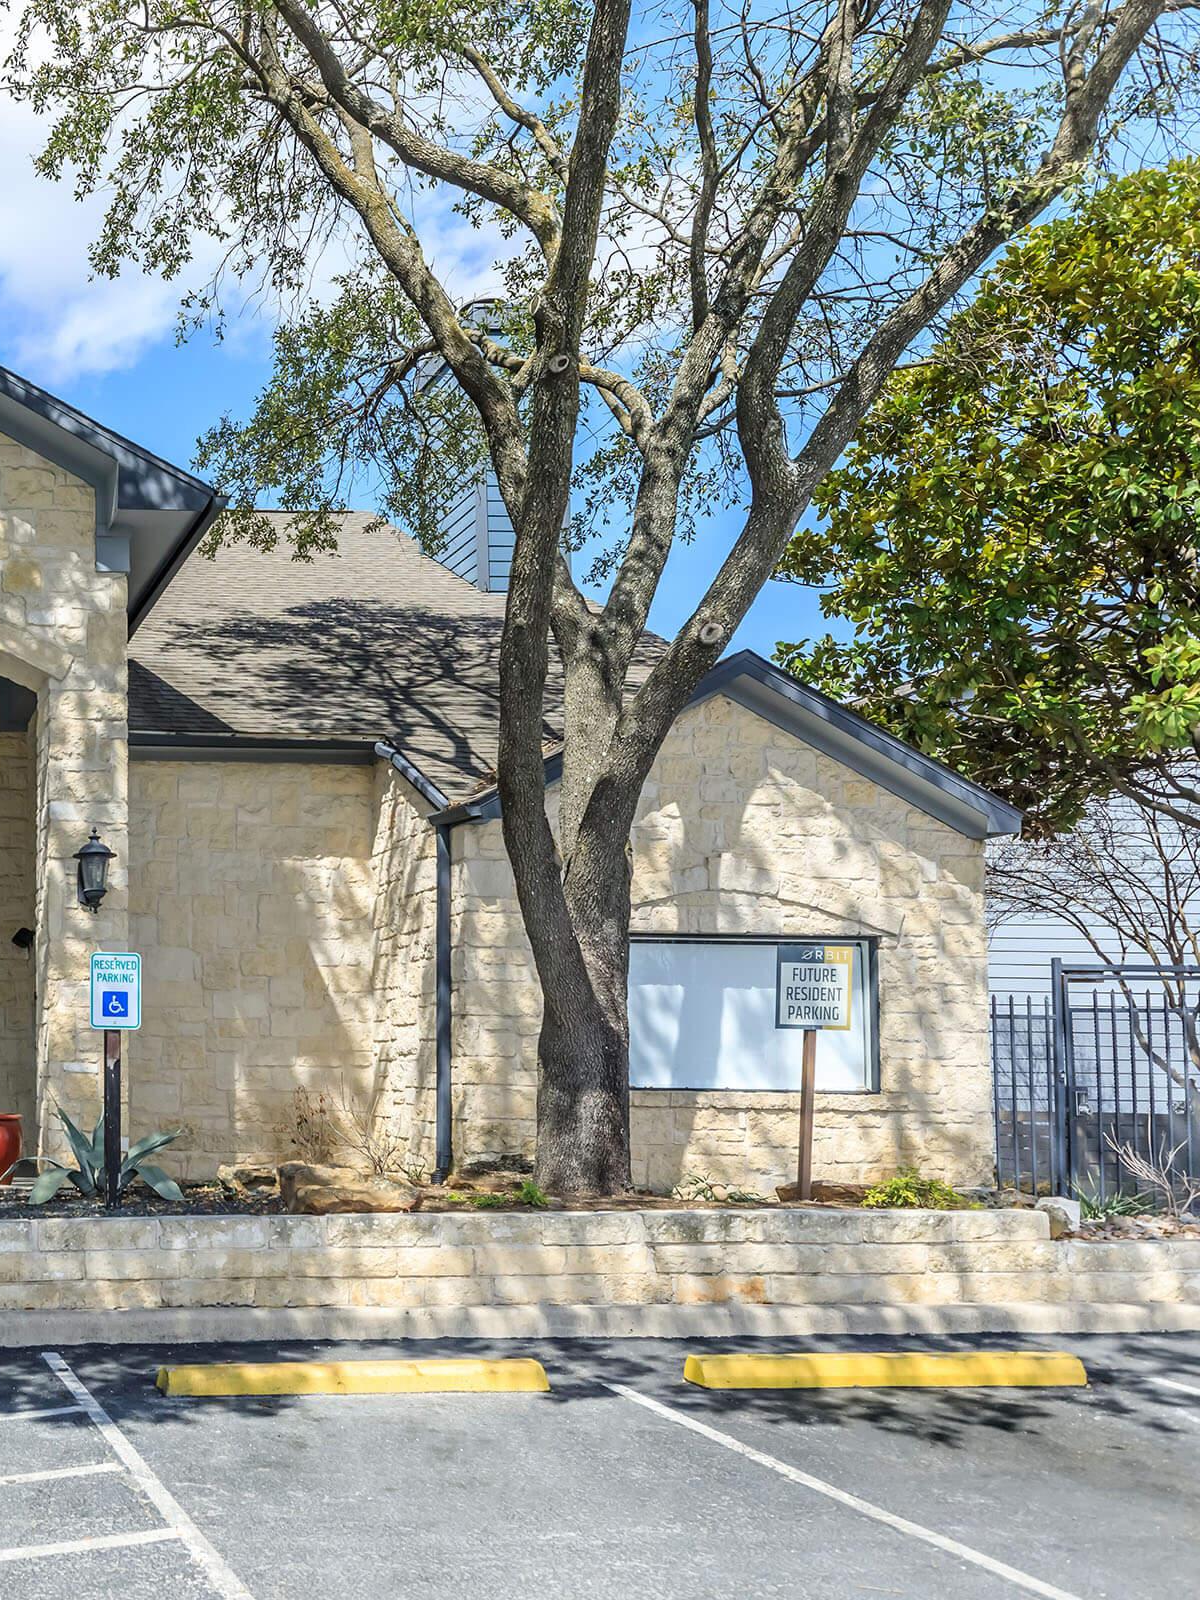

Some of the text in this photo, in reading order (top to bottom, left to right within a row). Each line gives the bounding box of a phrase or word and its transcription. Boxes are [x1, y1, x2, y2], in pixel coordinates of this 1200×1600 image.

[94, 959, 137, 971] RESERVED
[96, 972, 134, 983] PARKING
[792, 967, 837, 983] FUTURE
[786, 986, 842, 1002] RESIDENT
[787, 1005, 839, 1021] PARKING
